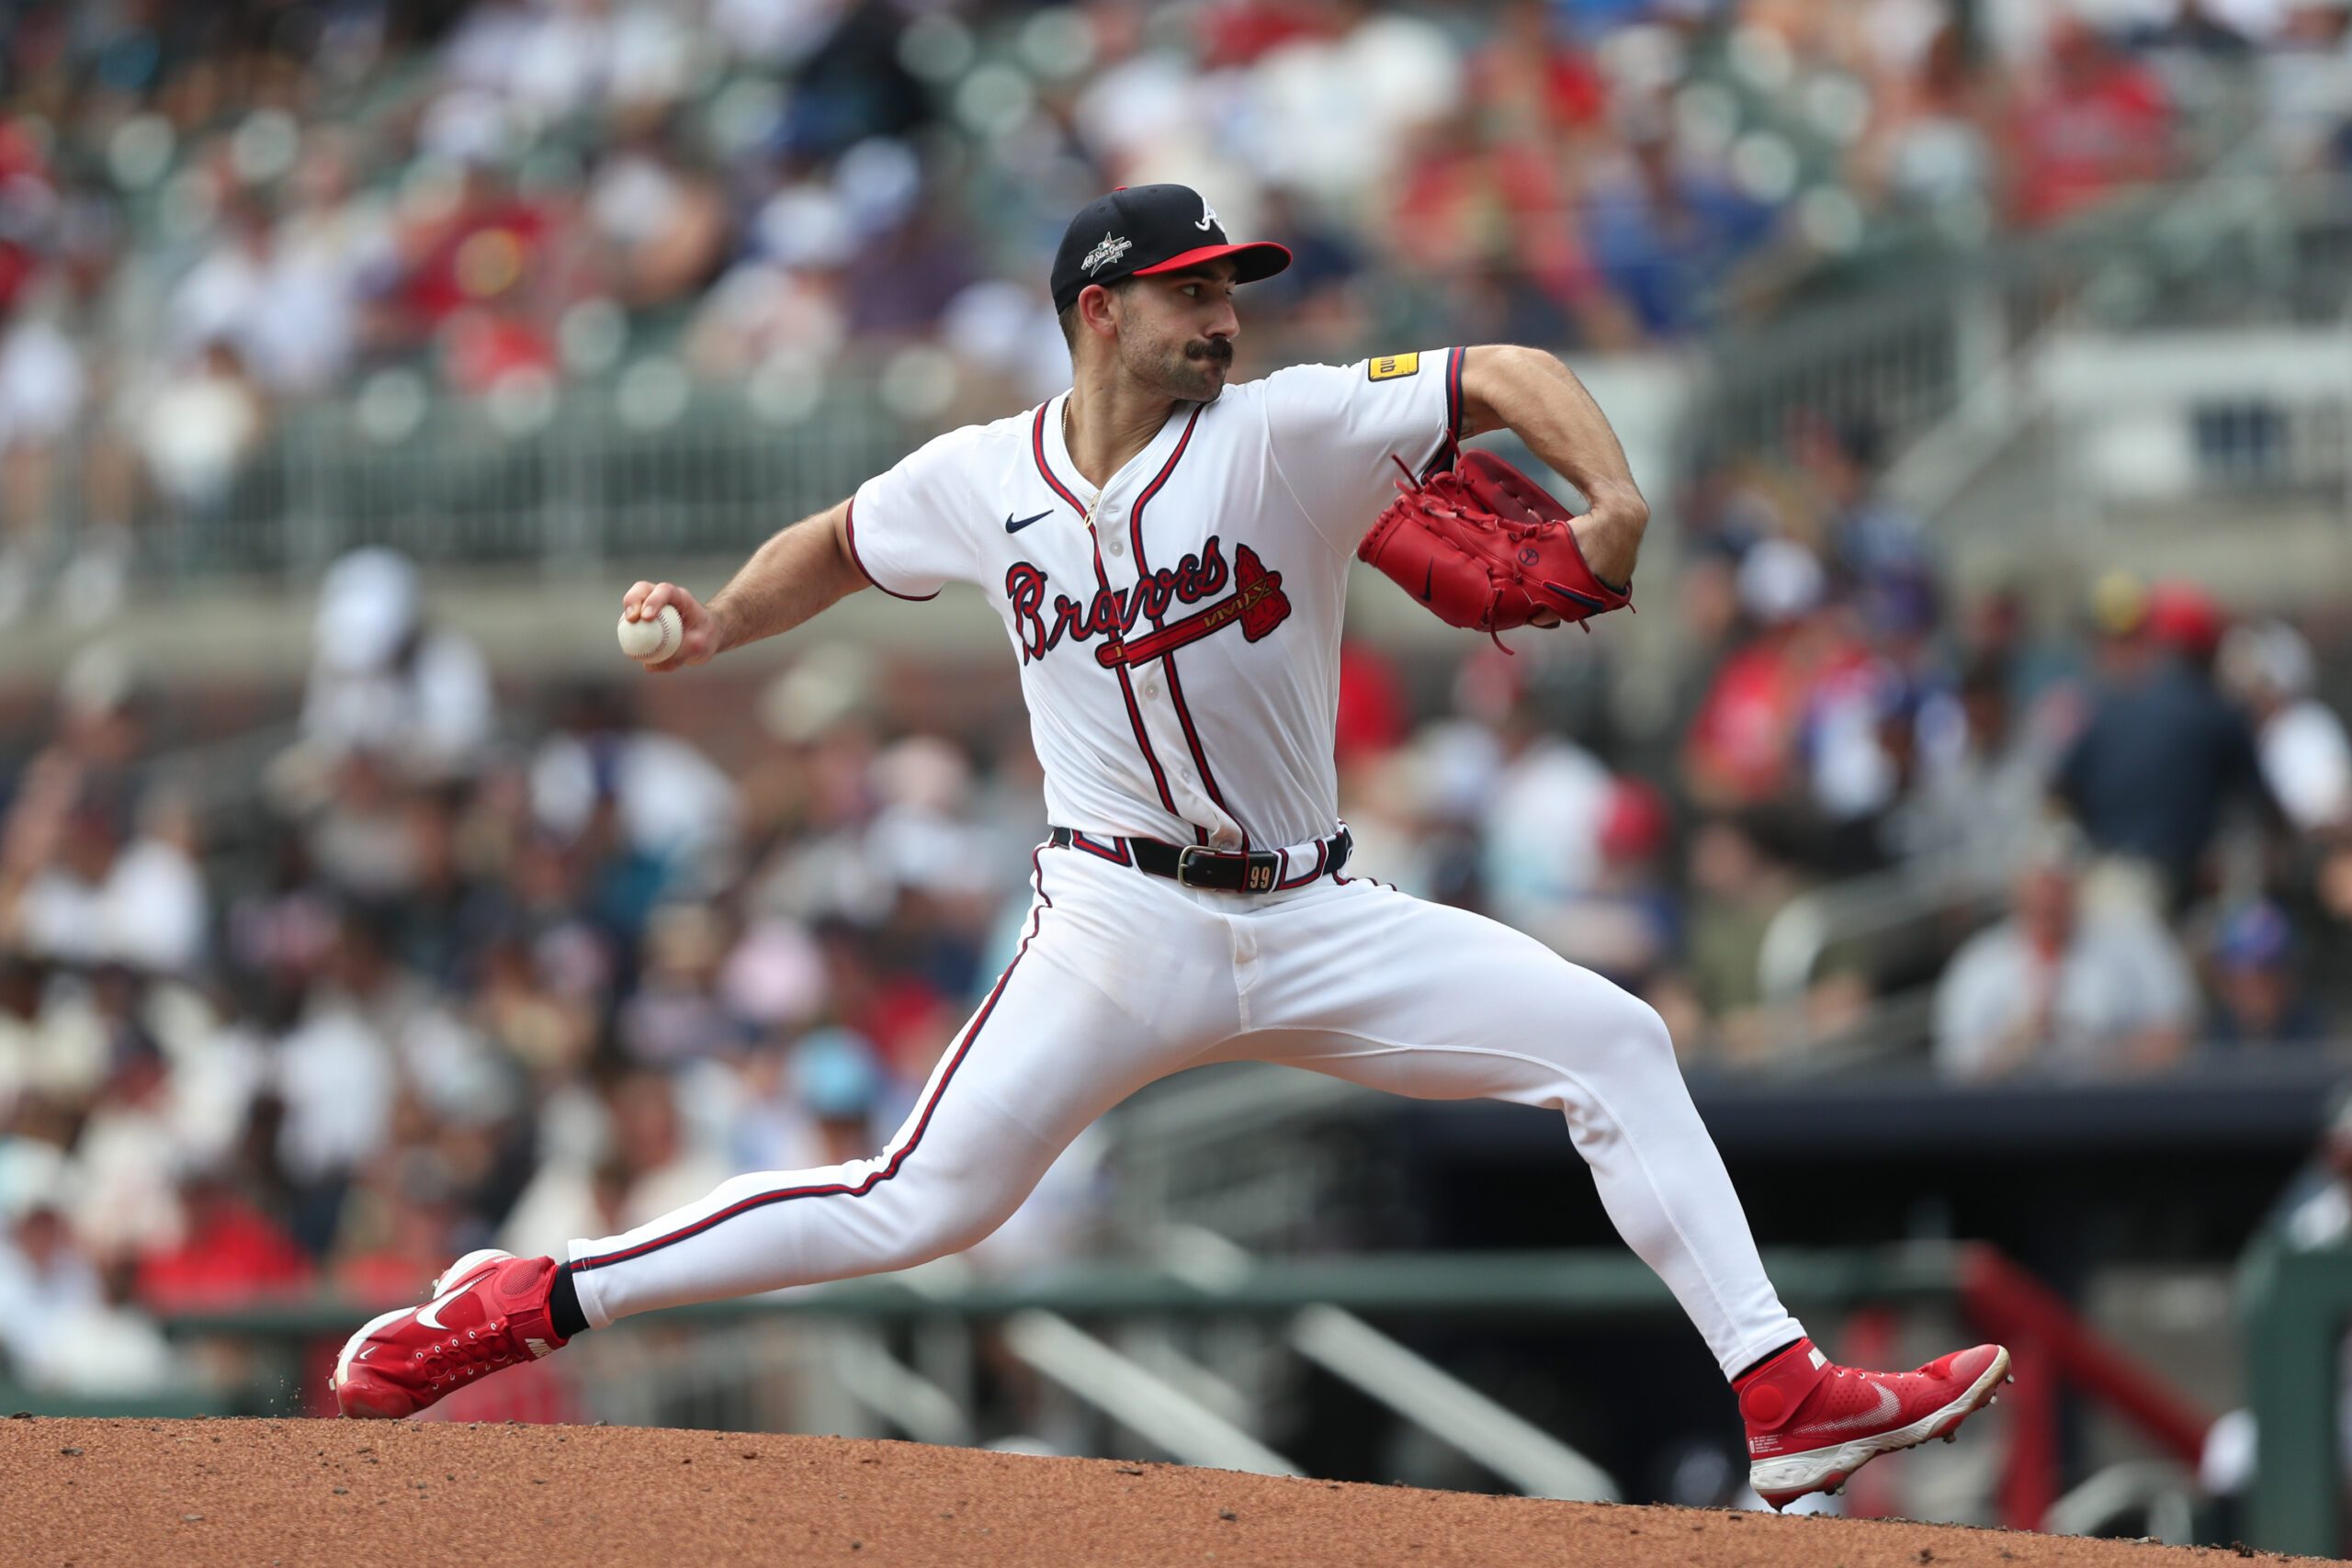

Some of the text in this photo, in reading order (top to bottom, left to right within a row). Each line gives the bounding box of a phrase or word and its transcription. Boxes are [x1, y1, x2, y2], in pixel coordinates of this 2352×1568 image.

[1380, 355, 1396, 374] QU
[1005, 535, 1228, 666] Braves
[1250, 865, 1271, 889] 99
